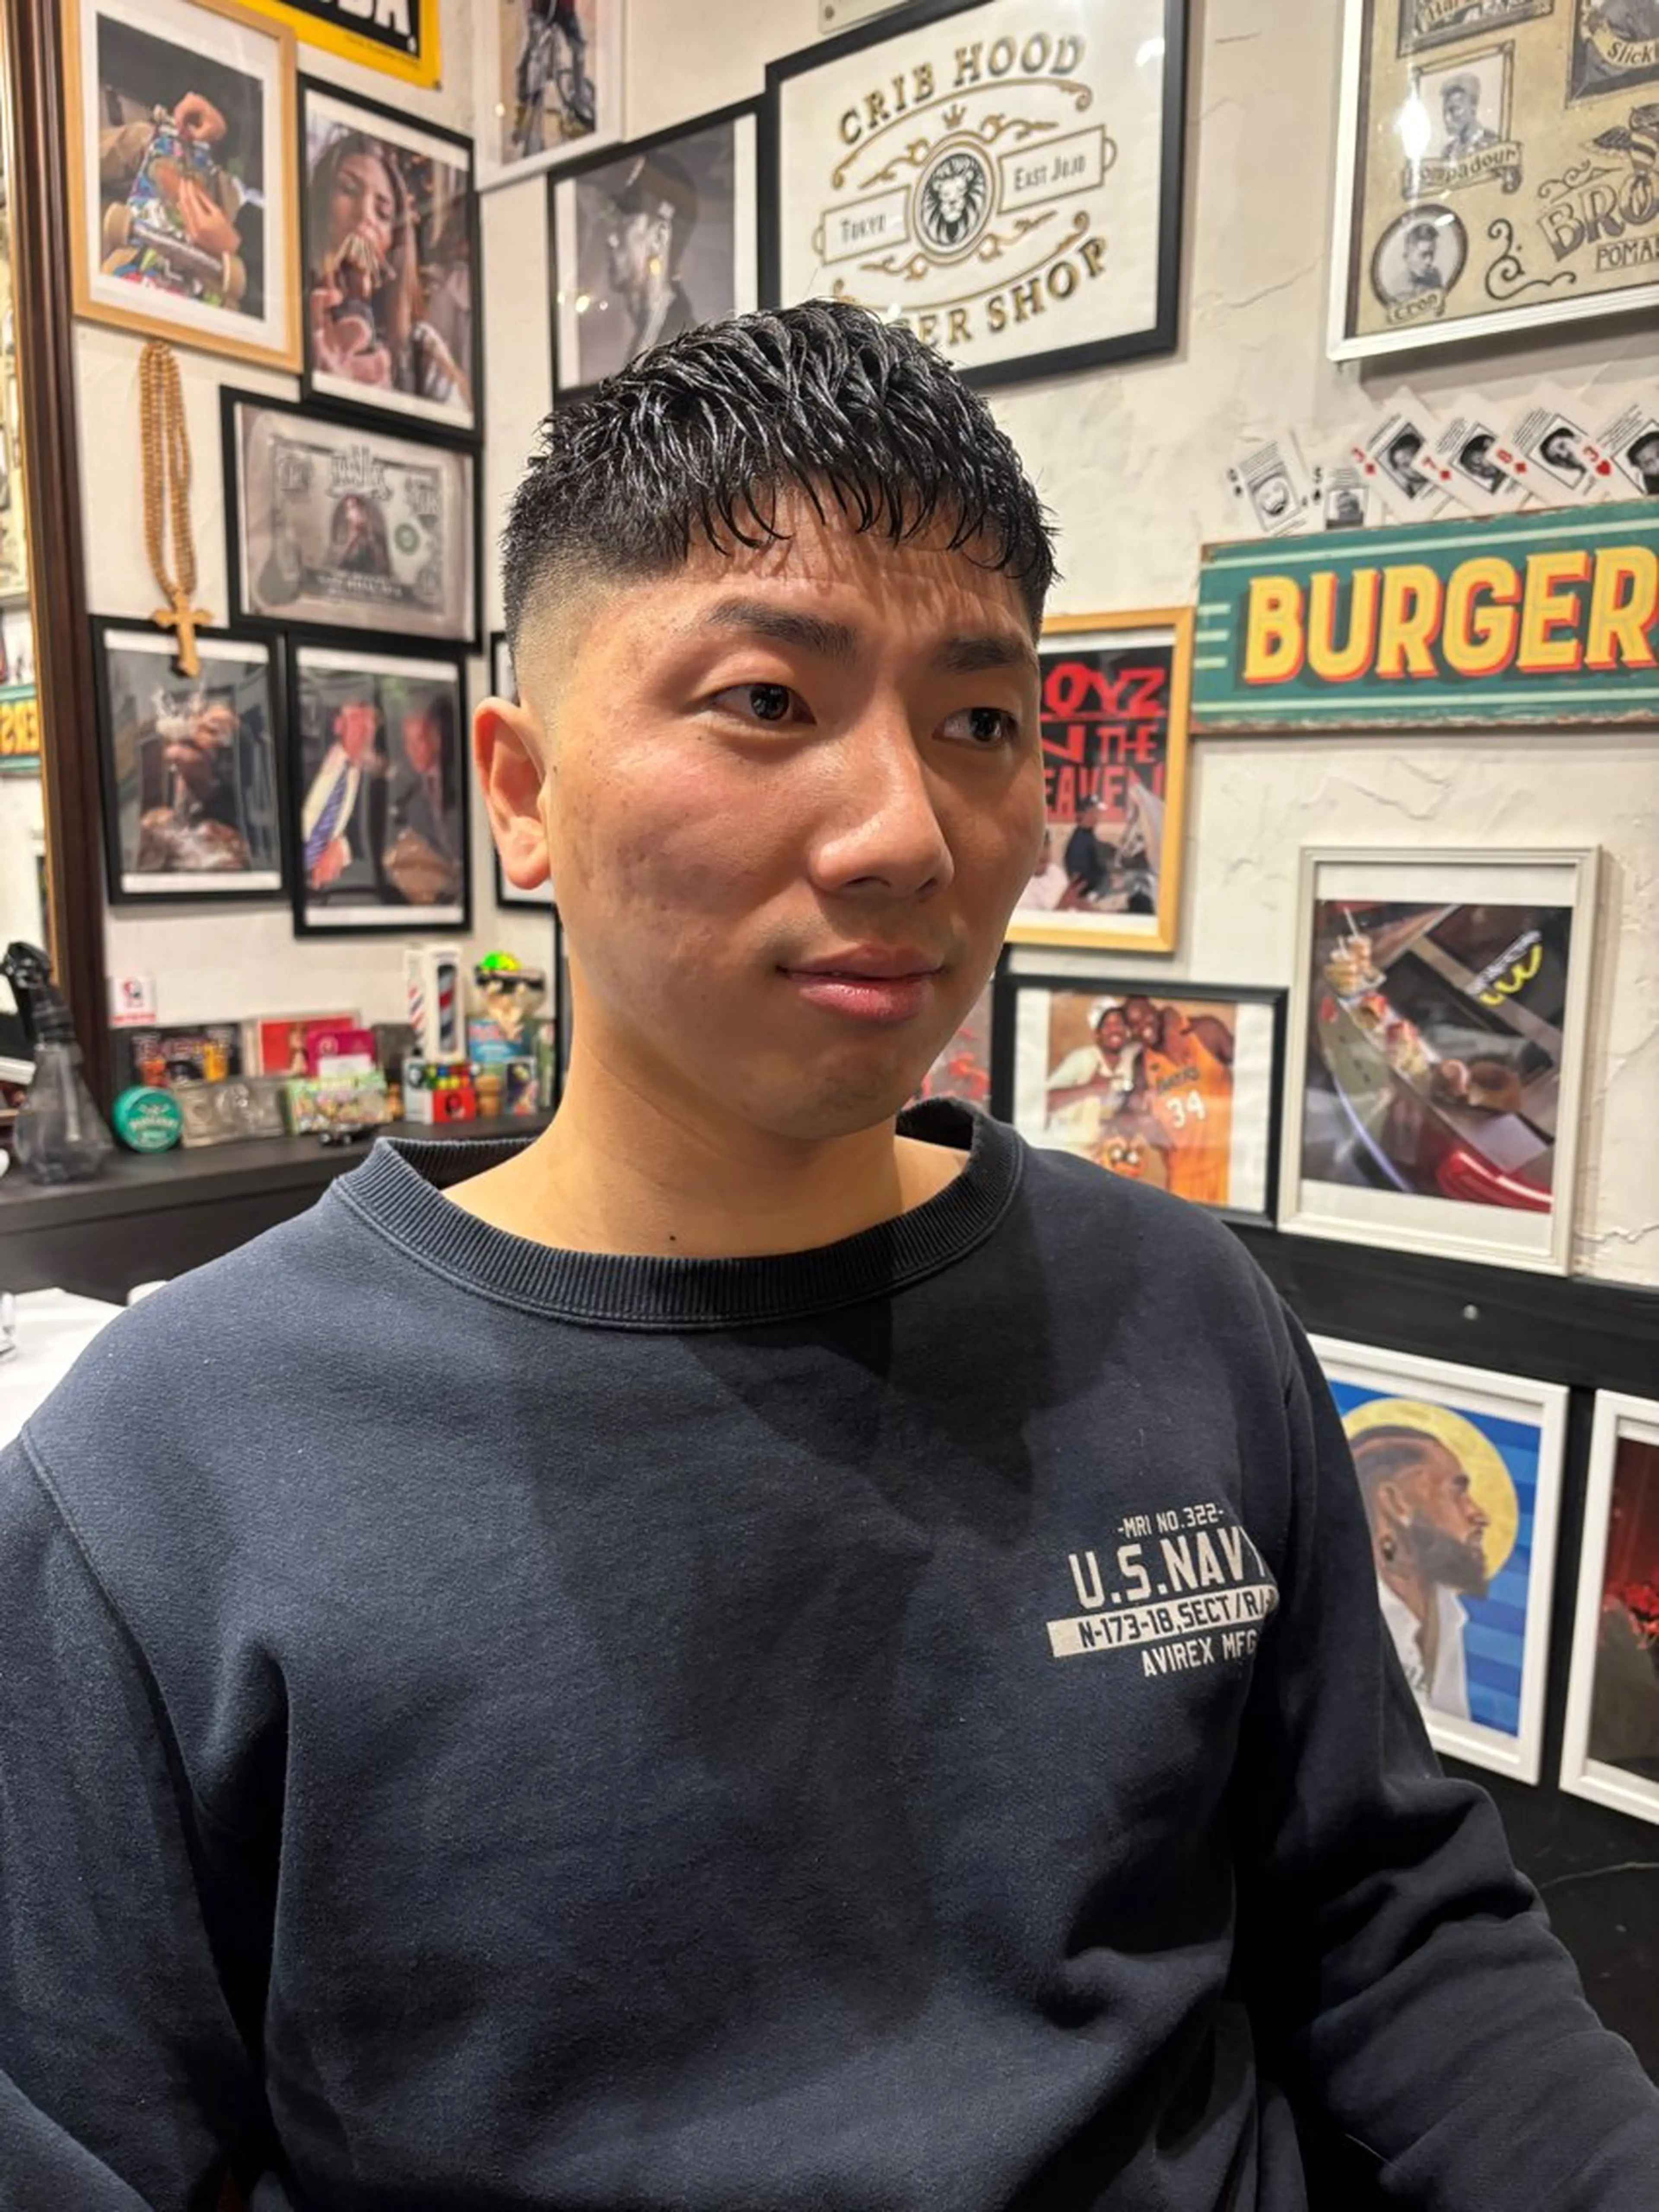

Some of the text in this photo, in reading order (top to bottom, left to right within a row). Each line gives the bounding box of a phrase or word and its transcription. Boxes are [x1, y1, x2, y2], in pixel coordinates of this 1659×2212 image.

[839, 32, 1086, 145] CRIB HOOD
[1596, 238, 1659, 271] POMA
[986, 238, 1107, 334] SHOP
[1243, 545, 1659, 685] BURGER
[1043, 662, 1166, 721] OYZ
[1044, 761, 1165, 824] EAVEN
[1166, 1089, 1206, 1129] 34
[1141, 1635, 1215, 1678] AVIREX
